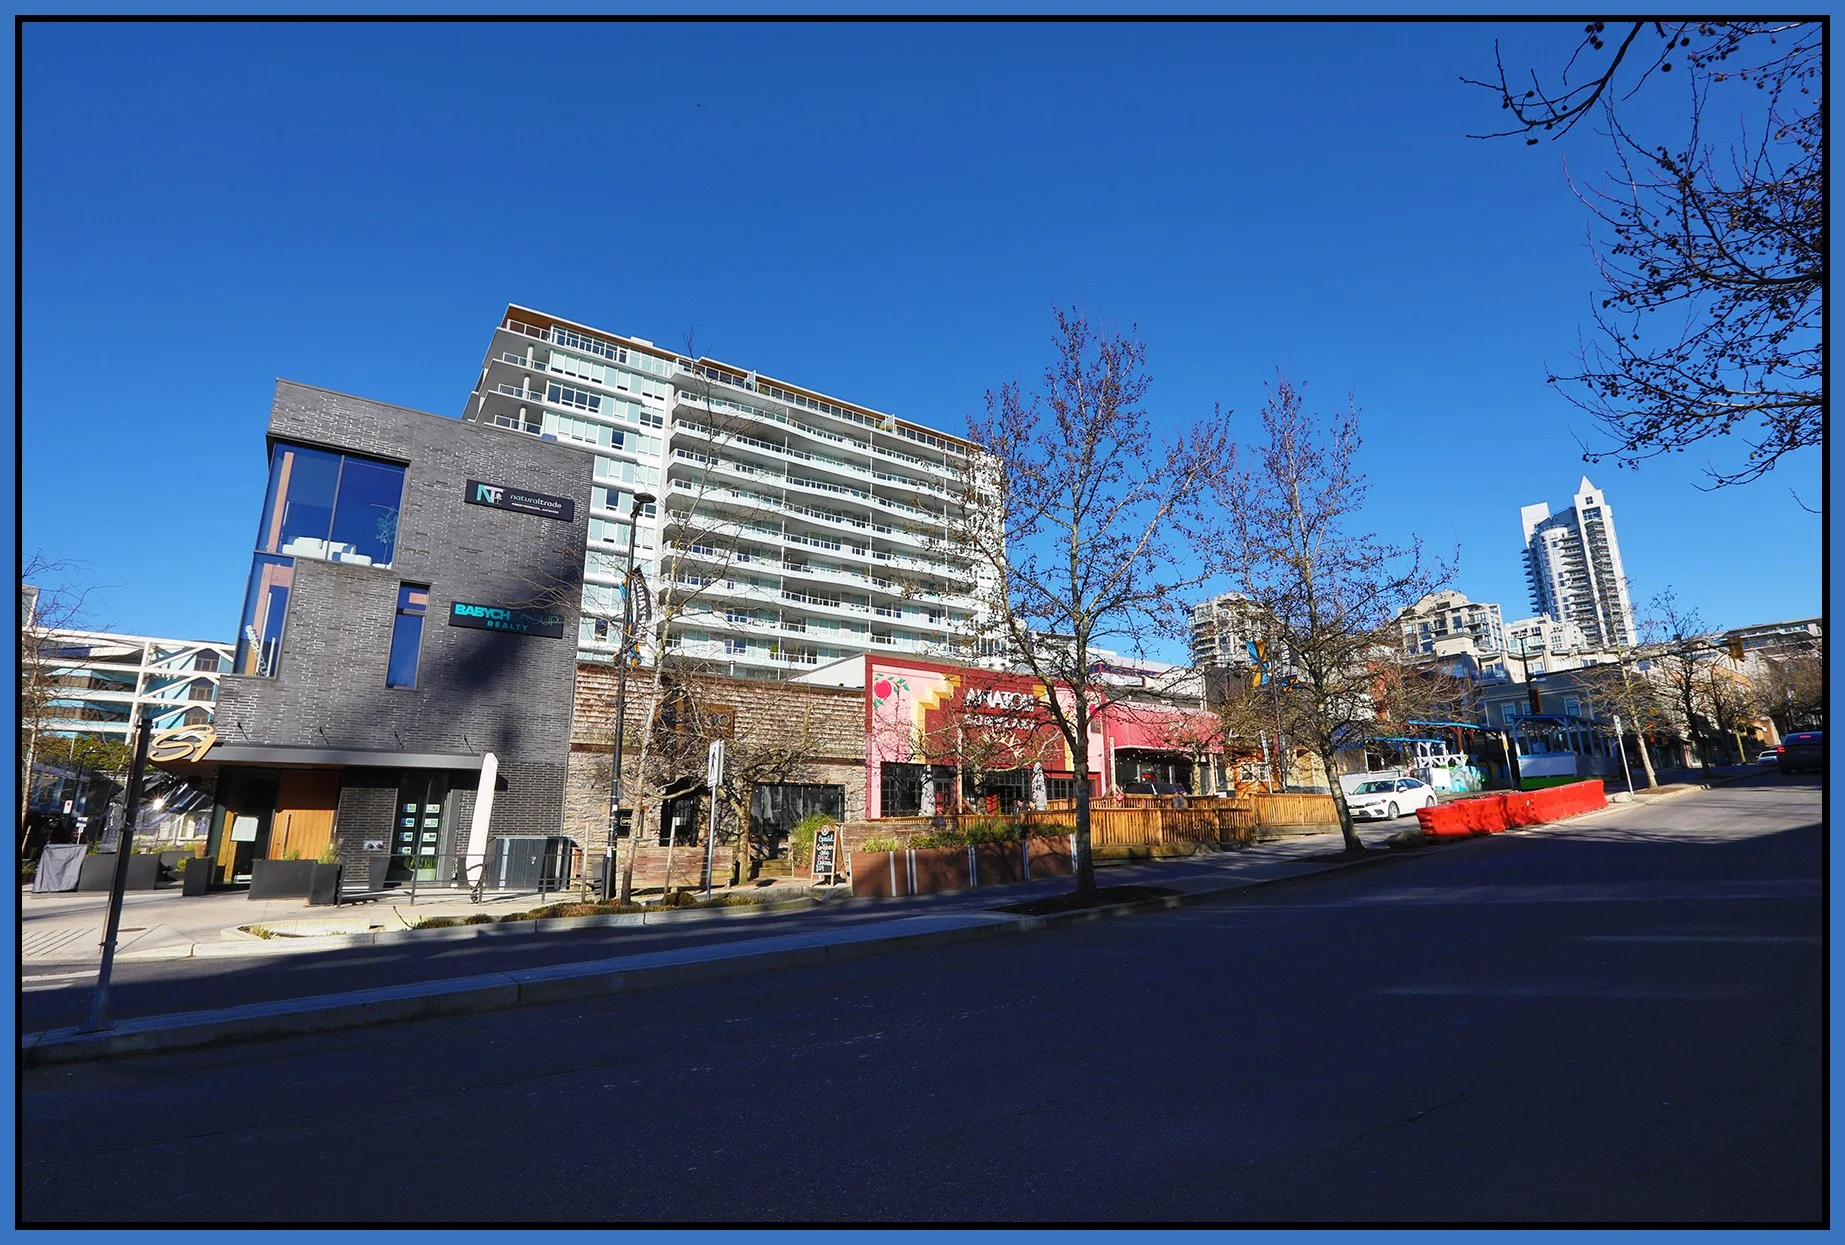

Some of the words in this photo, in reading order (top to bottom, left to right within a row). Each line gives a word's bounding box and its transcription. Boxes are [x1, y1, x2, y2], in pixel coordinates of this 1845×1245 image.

[510, 493, 562, 509] naturaltrade
[454, 603, 511, 622] BABYCH
[486, 620, 528, 631] REALTY
